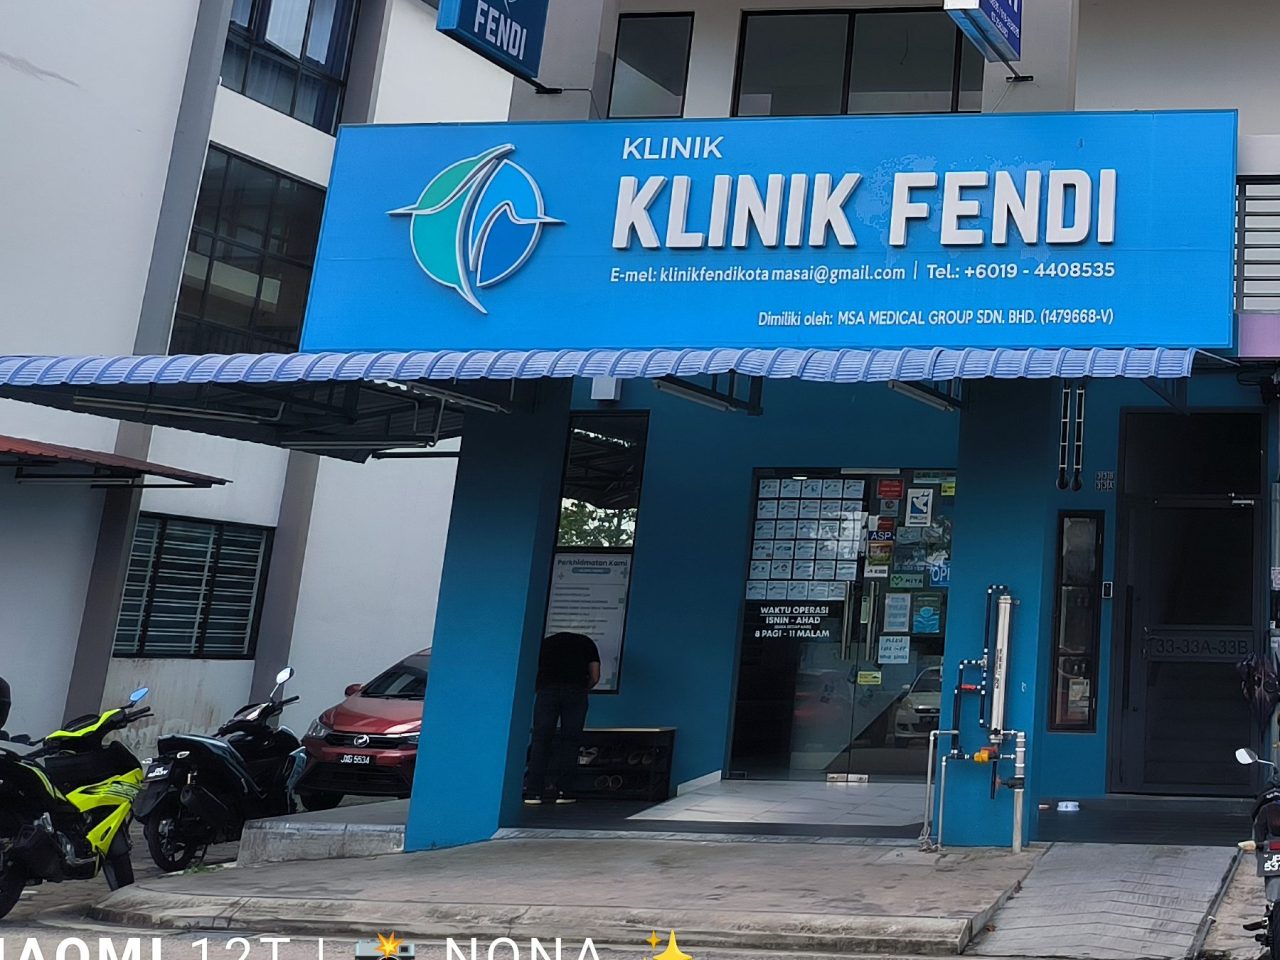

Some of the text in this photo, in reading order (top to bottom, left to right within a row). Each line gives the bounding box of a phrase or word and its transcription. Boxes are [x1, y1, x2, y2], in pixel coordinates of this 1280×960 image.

[474, 0, 527, 61] FENDI
[622, 136, 724, 160] KLINIK
[611, 168, 1118, 250] KLINIK FENDI
[610, 267, 657, 283] E-mel:
[927, 263, 960, 279] Tel.:
[964, 263, 1018, 279] +6019
[1034, 262, 1115, 278] 4408535
[758, 308, 1114, 326] Dimiliki oleh: MSA MEDICAL GROUP SDN. BHD. (1479668-V)
[870, 531, 892, 540] ASP
[557, 558, 628, 567] Perkhidmatan Kami
[760, 606, 829, 614] WAKTU OPERASI
[765, 616, 789, 624] ISNIN
[795, 616, 821, 624] AHAD
